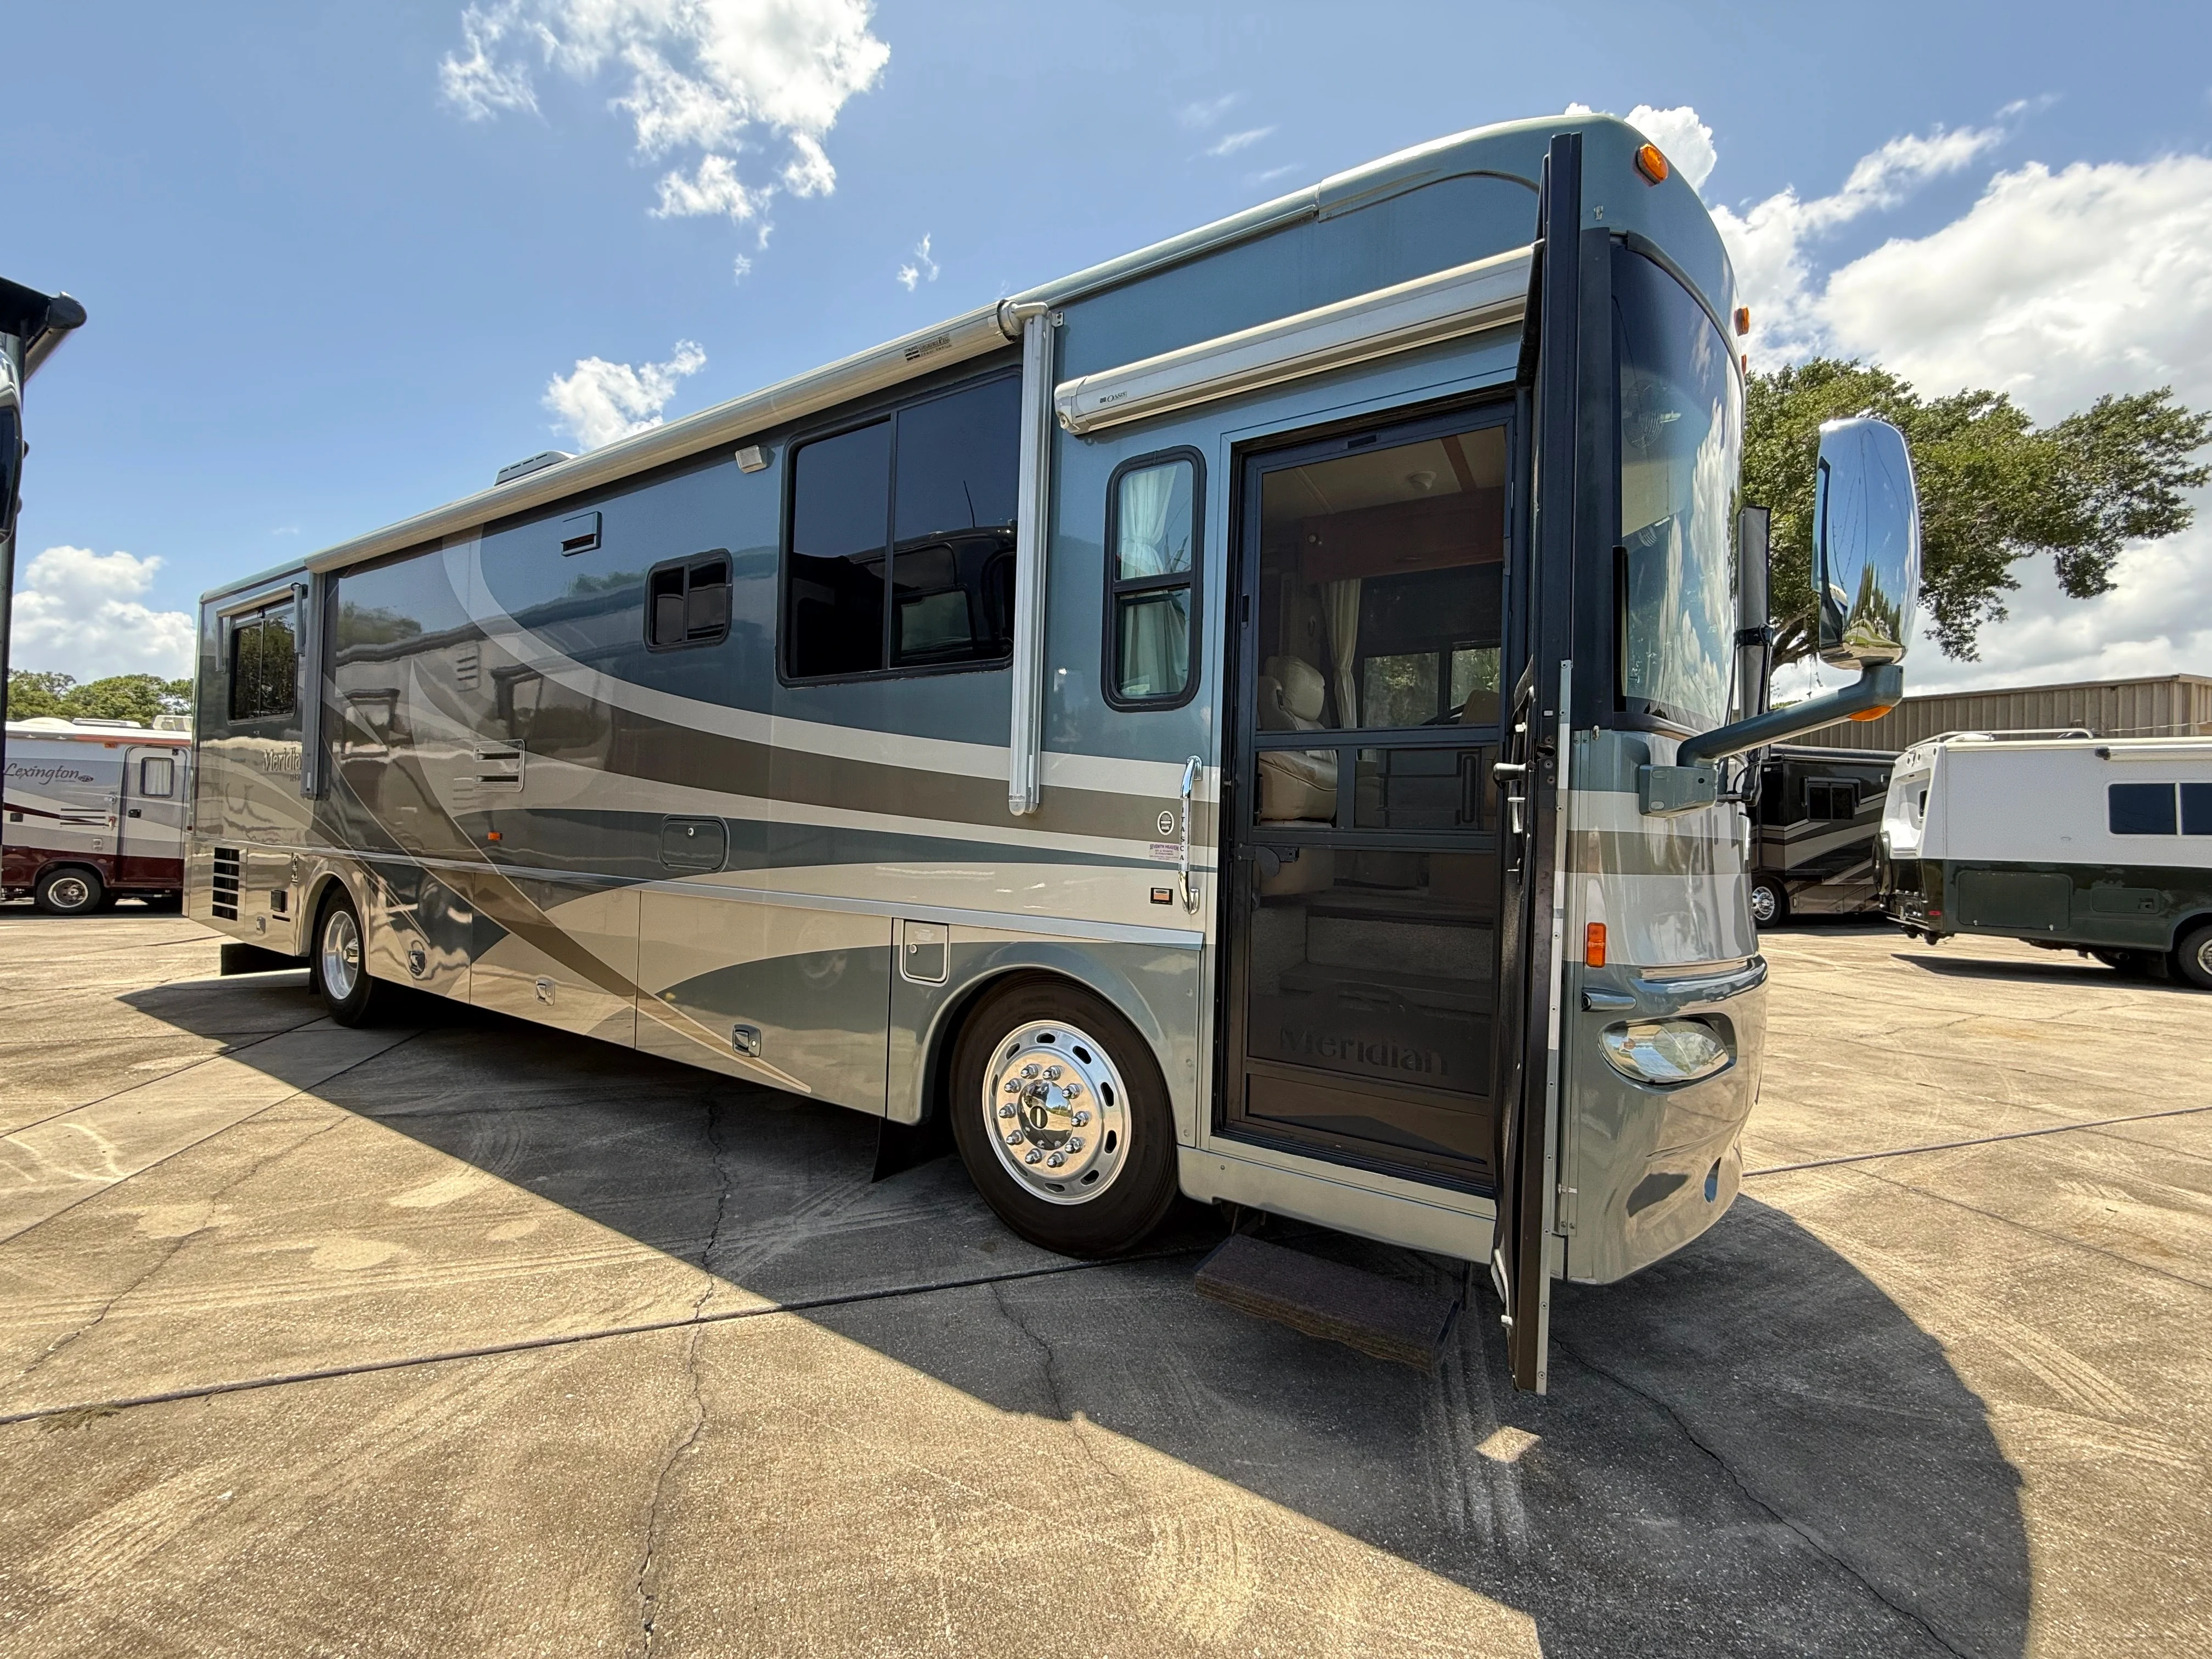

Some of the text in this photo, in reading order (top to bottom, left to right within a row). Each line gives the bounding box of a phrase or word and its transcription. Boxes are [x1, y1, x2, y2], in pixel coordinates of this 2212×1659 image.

[263, 747, 302, 772] Meridia
[3, 763, 80, 785] Lexington
[1279, 1026, 1449, 1076] Meridian
